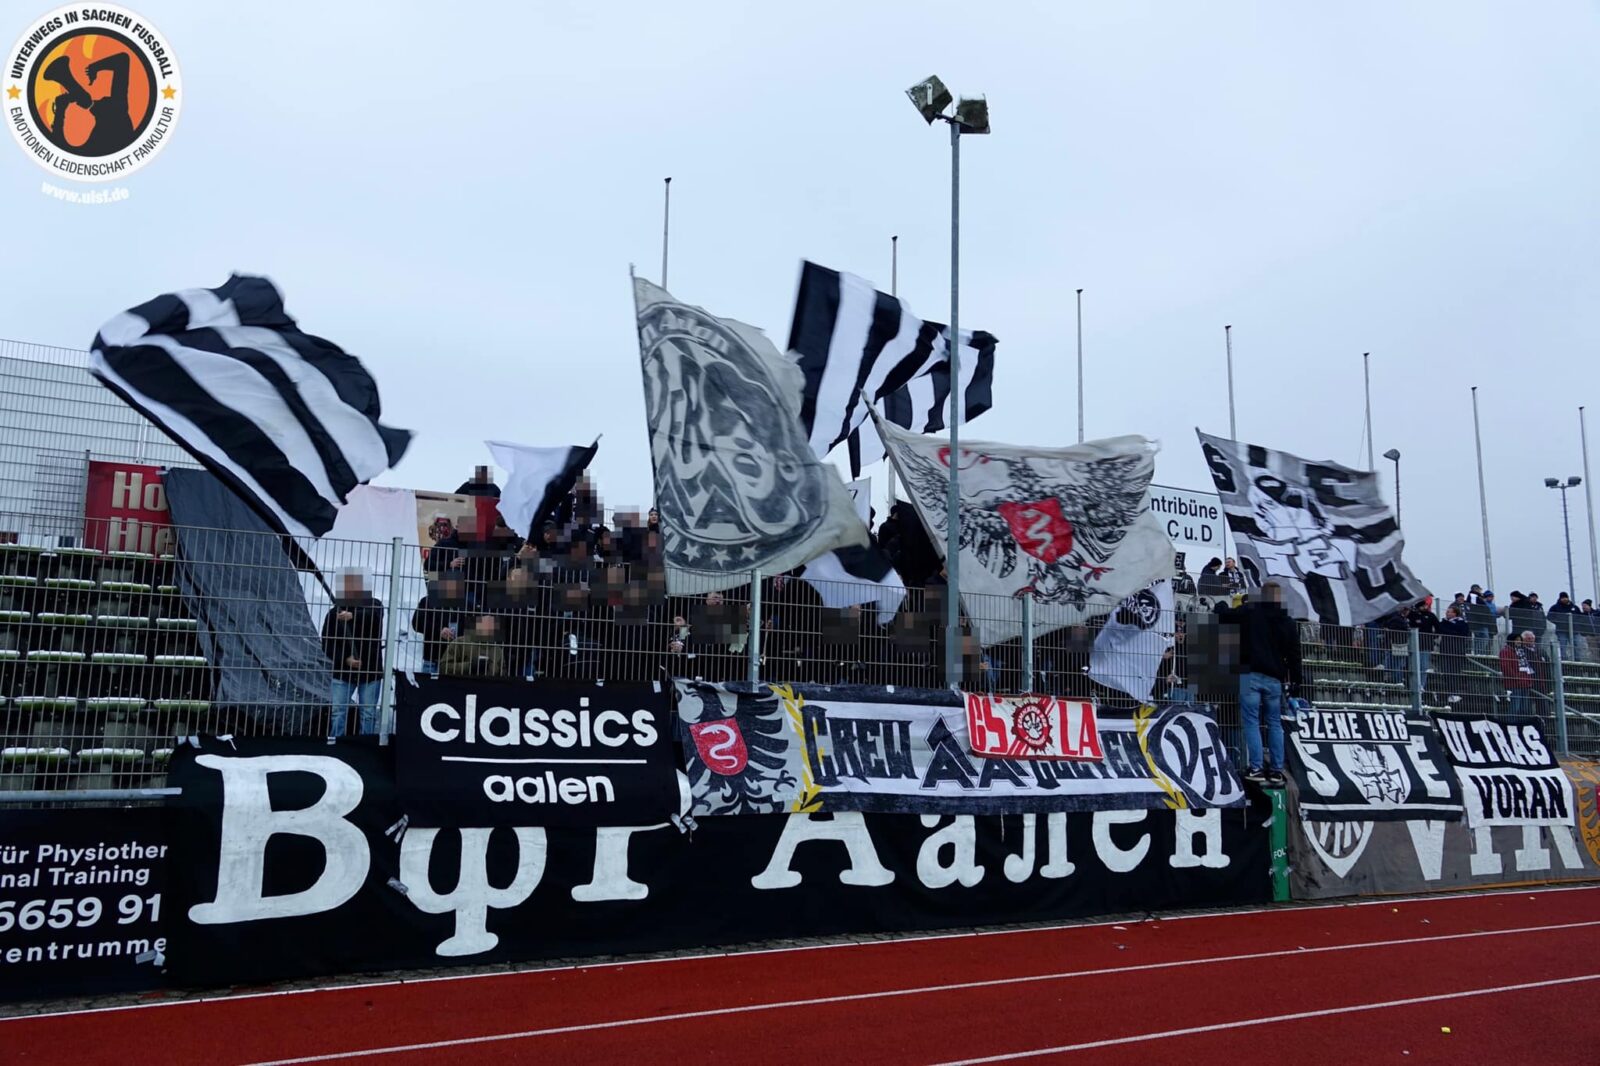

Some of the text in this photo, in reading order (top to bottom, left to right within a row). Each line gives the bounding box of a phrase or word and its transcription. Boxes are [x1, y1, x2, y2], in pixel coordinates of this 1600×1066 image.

[1151, 495, 1218, 520] ntribüne
[1167, 519, 1179, 538] C
[1201, 524, 1212, 542] D
[420, 694, 658, 749] classics
[1297, 711, 1409, 740] SZENE 1916
[800, 705, 919, 787] CREW
[1437, 718, 1551, 766] ULTRAS
[482, 771, 615, 805] aalen
[1469, 774, 1568, 819] VORAN
[0, 841, 168, 867] ür Physiother
[48, 864, 150, 887] Training
[117, 893, 162, 925] 91
[0, 937, 167, 964] entrumme
